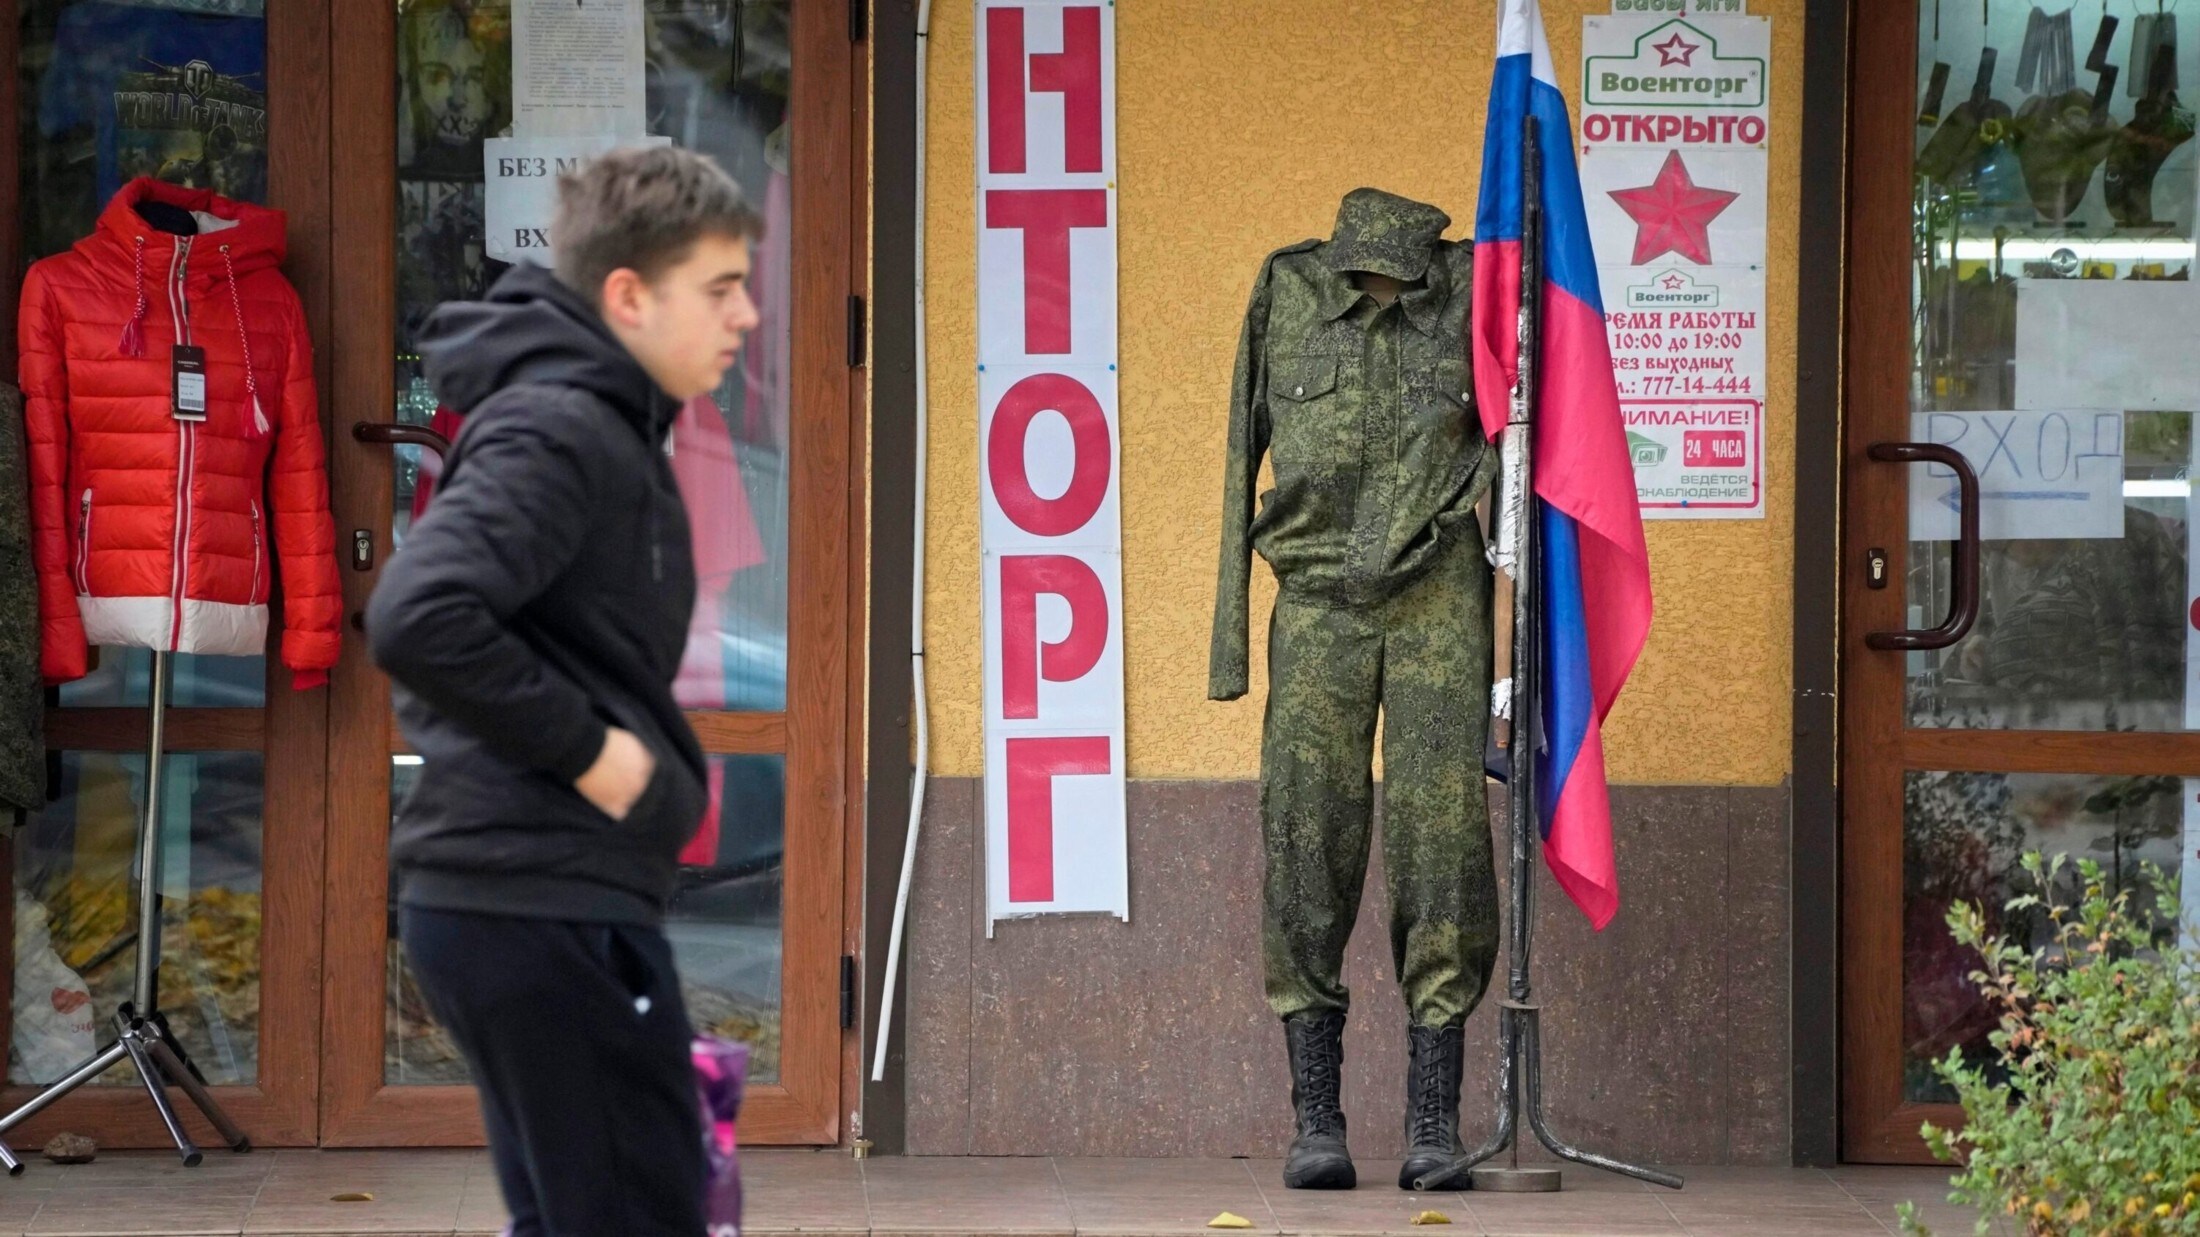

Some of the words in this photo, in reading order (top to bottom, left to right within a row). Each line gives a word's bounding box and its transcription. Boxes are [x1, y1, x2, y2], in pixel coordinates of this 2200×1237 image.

[1601, 72, 1748, 98] Военторг
[113, 92, 193, 129] WORLD
[1583, 114, 1766, 144] ОТКРЫТО
[498, 157, 547, 177] БЕЗ
[514, 228, 550, 248] ВХ
[1635, 292, 1710, 303] Военторг
[1604, 312, 1662, 329] РЕМЯ
[1669, 312, 1756, 329] РАБОТЫ
[1615, 332, 1662, 349] 10:00
[1668, 337, 1688, 352] до
[1694, 332, 1742, 349] 19:00
[1643, 376, 1751, 395] 777-14-444
[1623, 410, 1749, 425] ИМАНИЕ!
[1686, 439, 1701, 458] 24
[1712, 439, 1743, 458] ЧАСА
[1928, 412, 2124, 484] ВХОД
[1637, 487, 1748, 499] ОНАБЛЮДЕНИЕ
